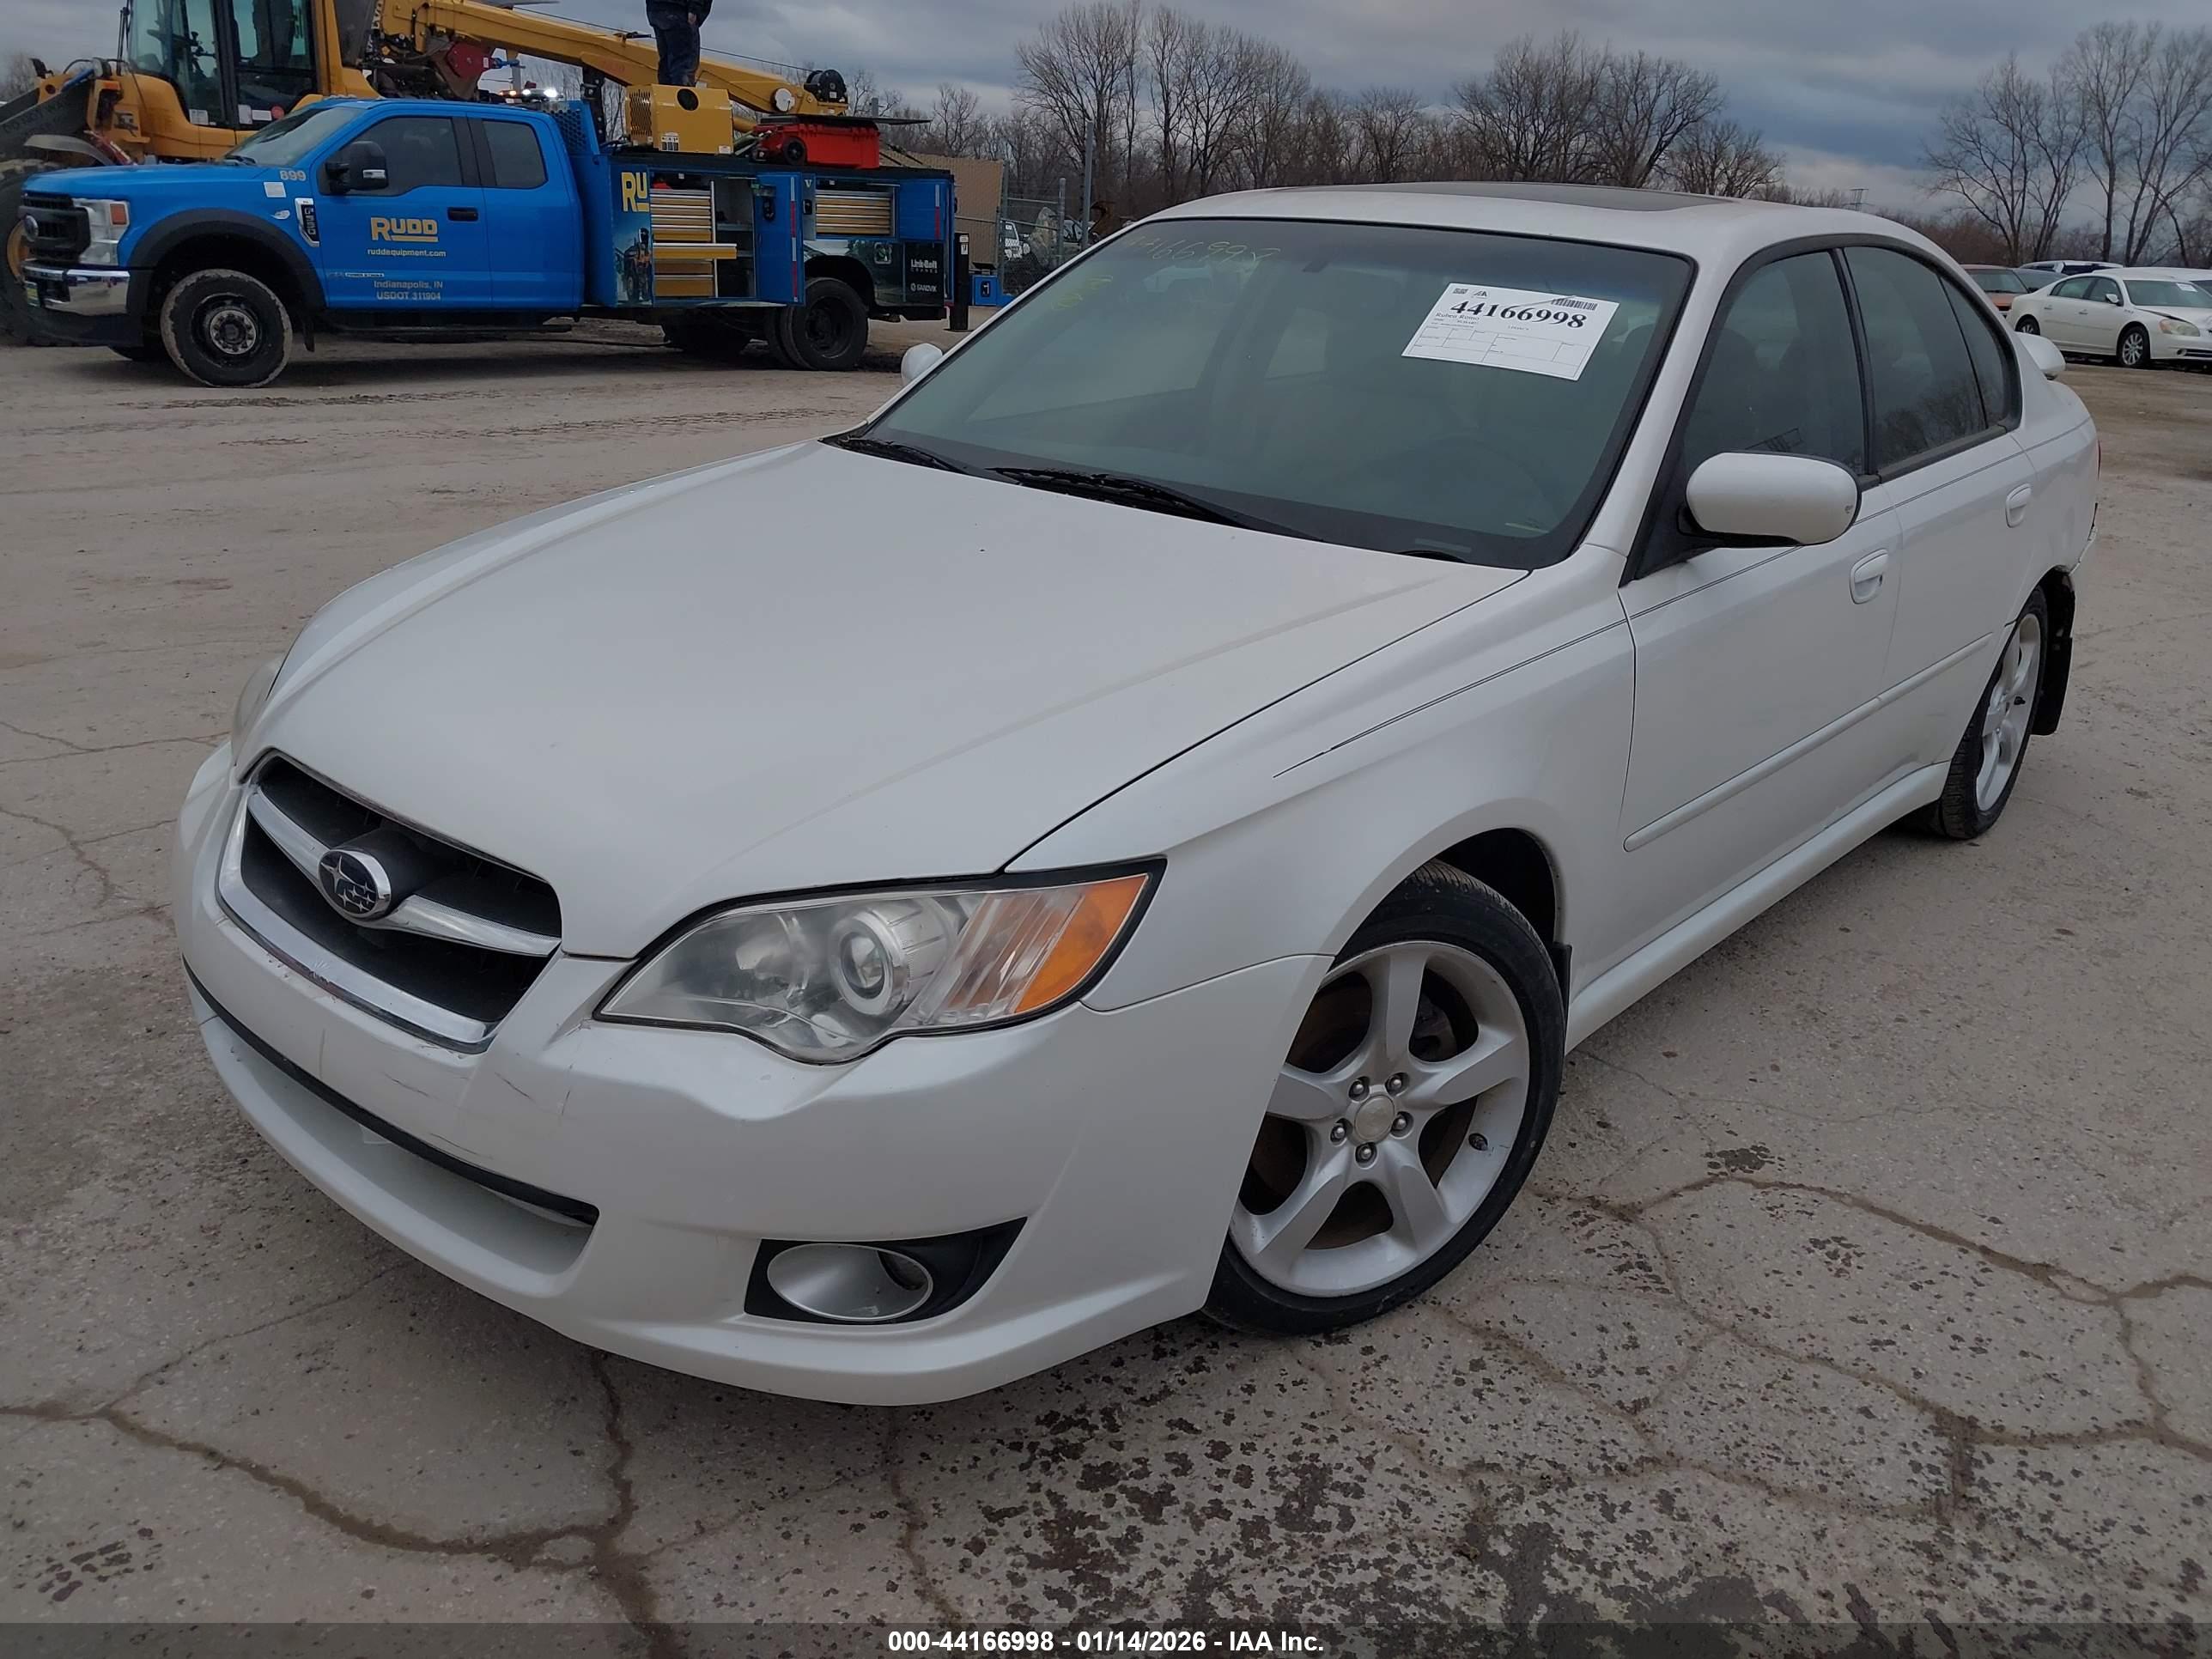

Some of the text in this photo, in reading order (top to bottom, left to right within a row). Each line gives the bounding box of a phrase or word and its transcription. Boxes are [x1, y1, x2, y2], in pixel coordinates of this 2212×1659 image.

[279, 170, 307, 182] 899
[370, 216, 439, 241] RUDD
[368, 248, 447, 257] ruddequipment.com
[1450, 301, 1587, 328] 44166998
